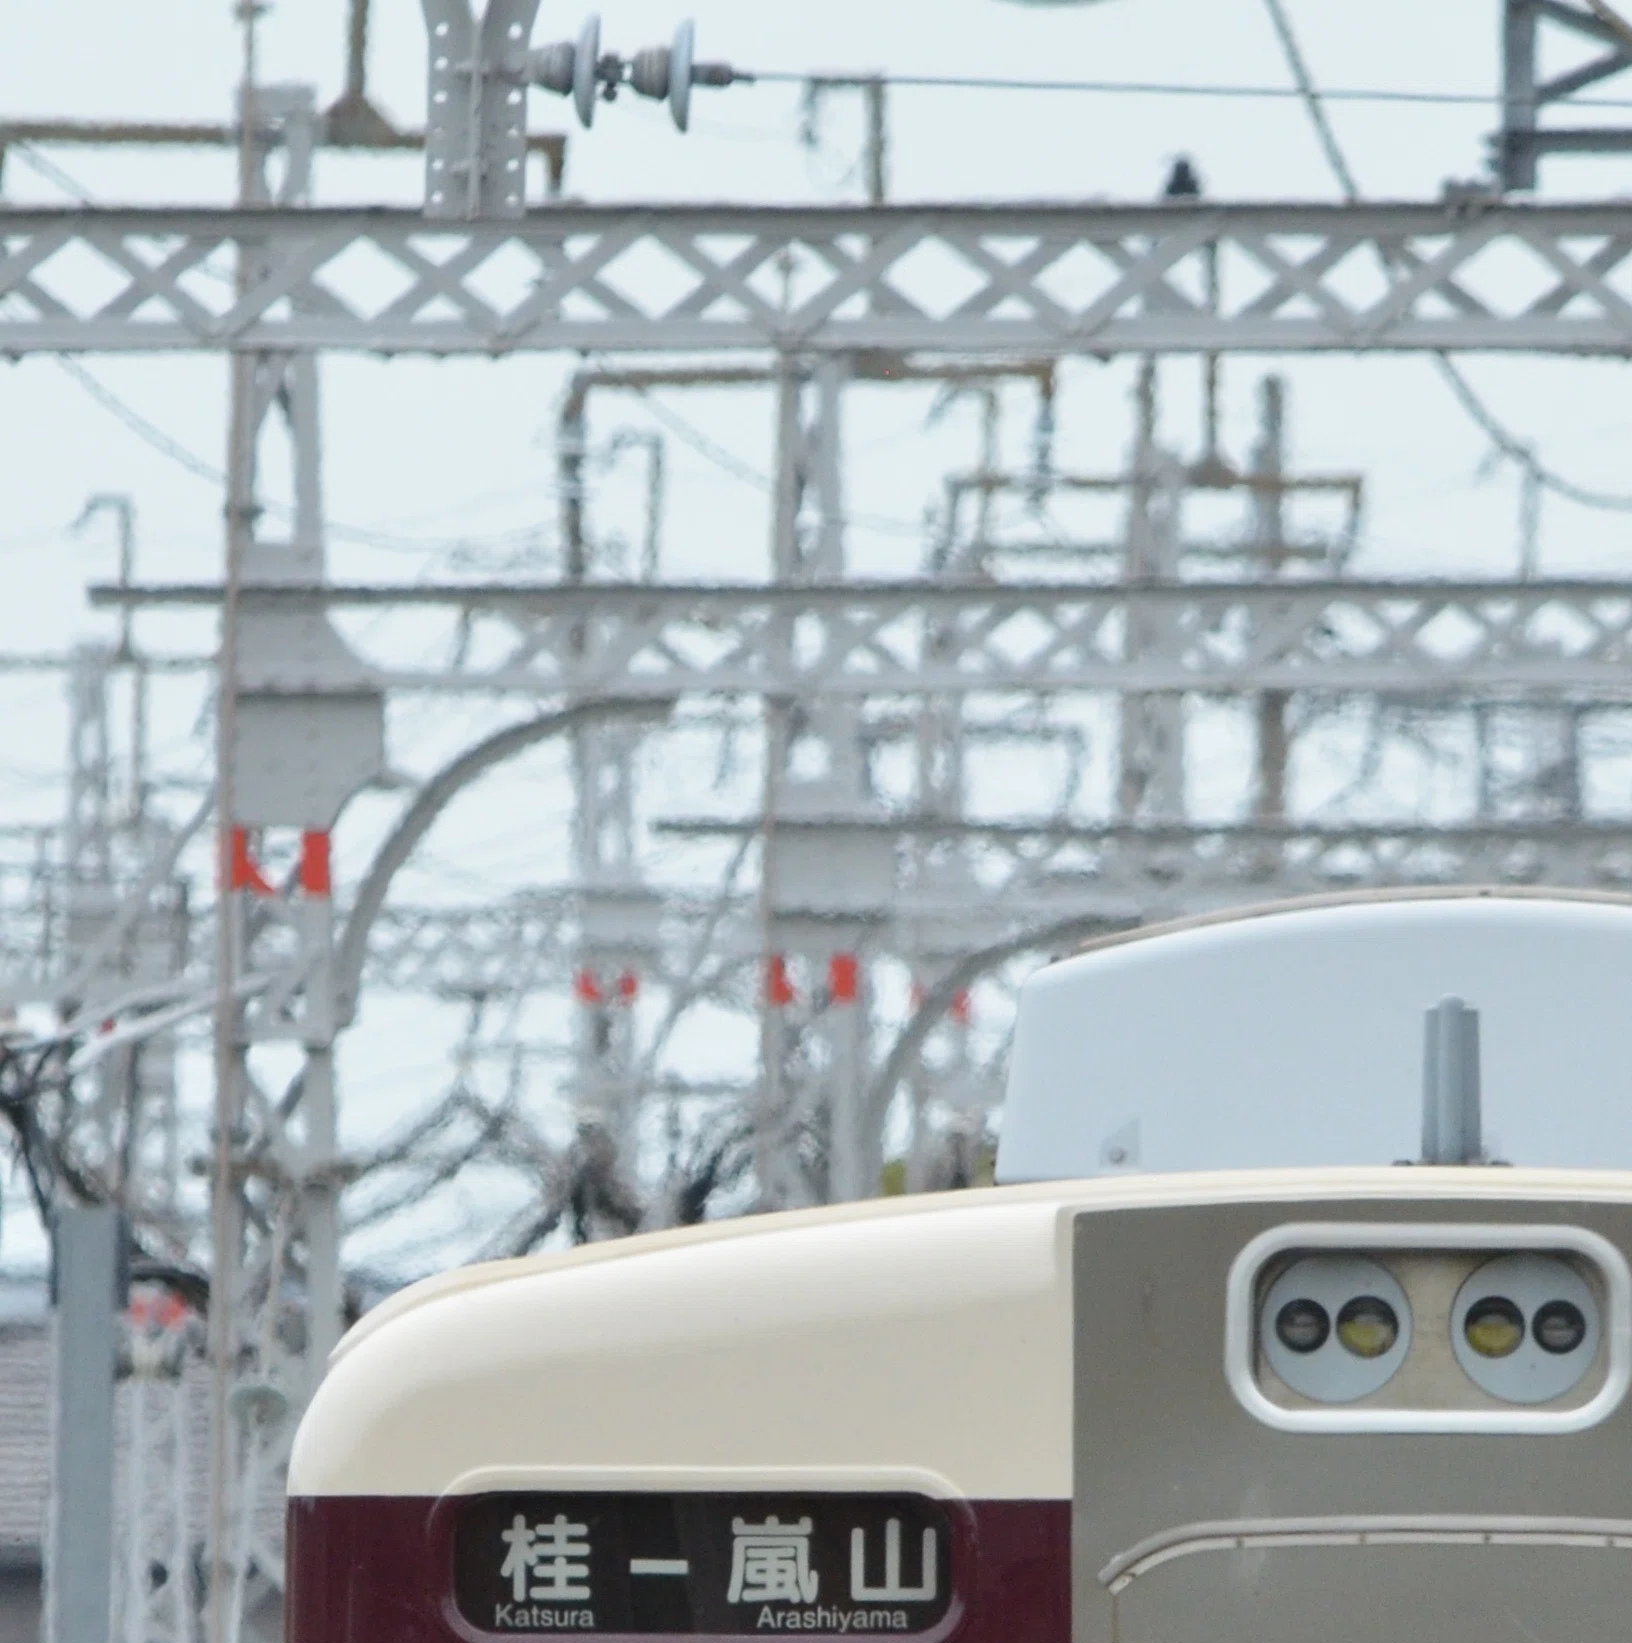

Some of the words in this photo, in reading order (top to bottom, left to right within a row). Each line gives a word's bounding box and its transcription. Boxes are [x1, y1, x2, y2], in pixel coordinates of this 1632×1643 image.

[500, 1513, 591, 1603] 桂
[726, 1515, 938, 1604] 嵐山
[495, 1604, 595, 1628] Katsura
[756, 1605, 908, 1633] Arashiyama
